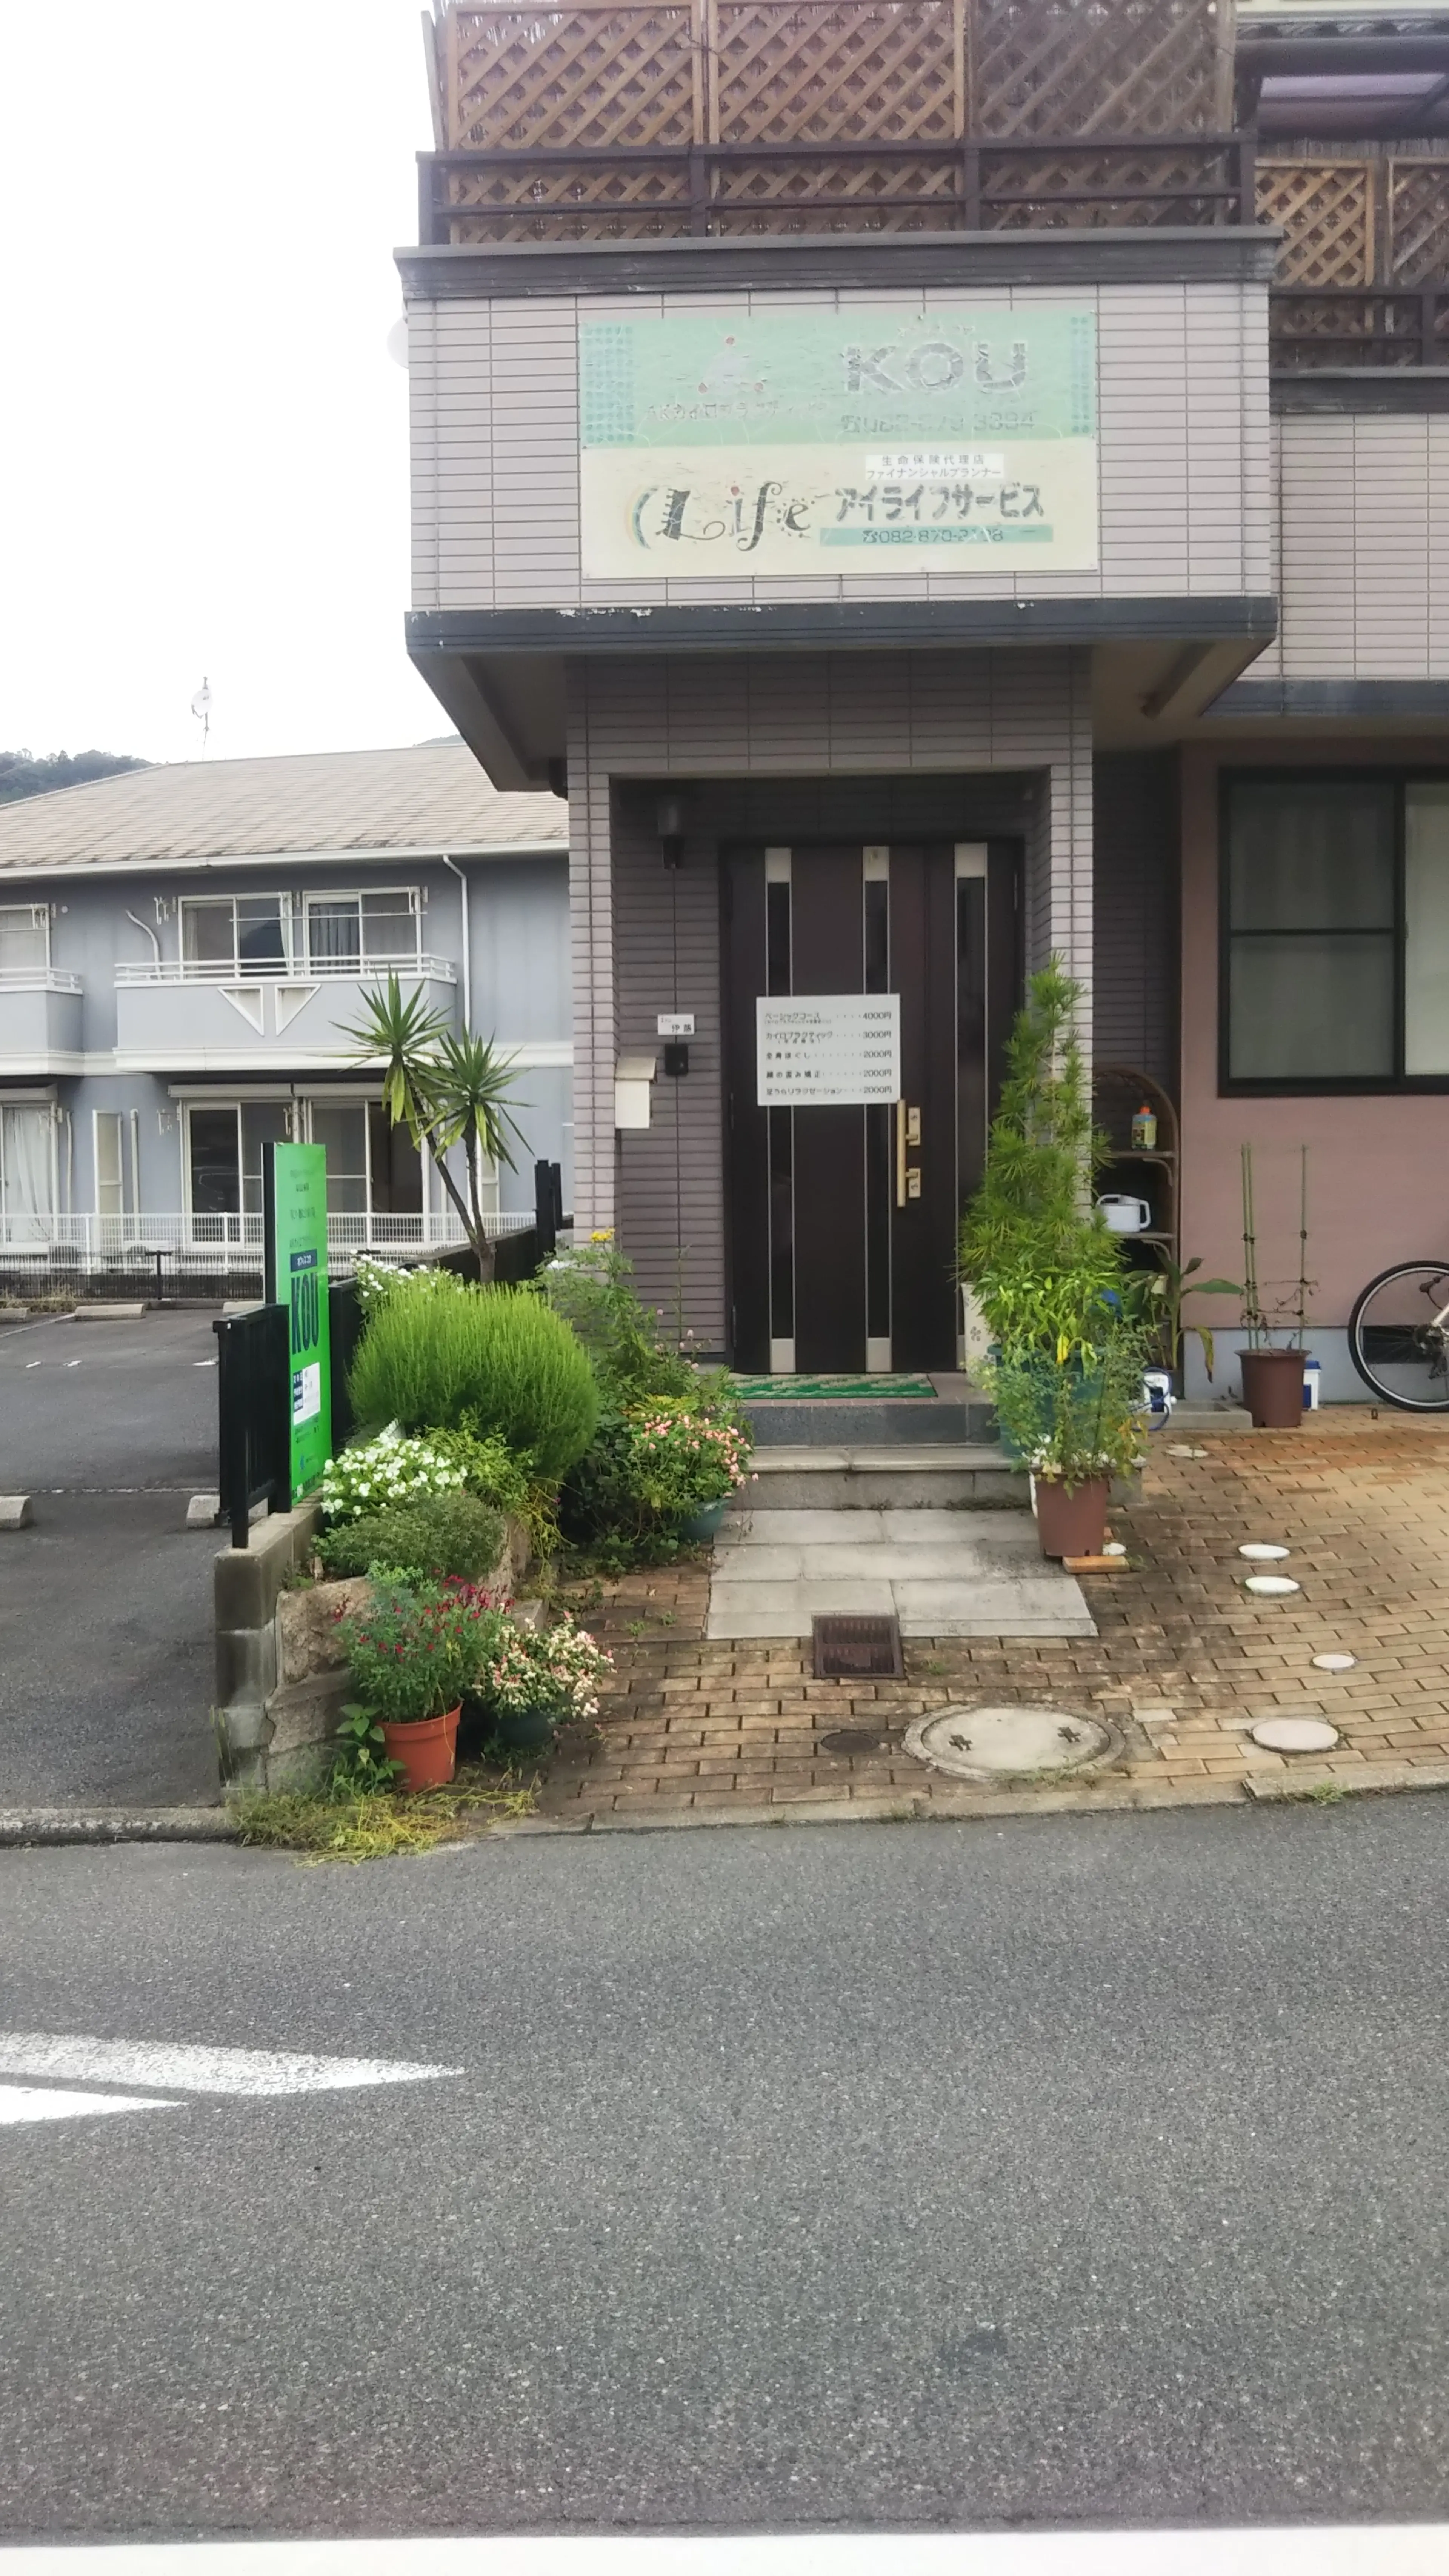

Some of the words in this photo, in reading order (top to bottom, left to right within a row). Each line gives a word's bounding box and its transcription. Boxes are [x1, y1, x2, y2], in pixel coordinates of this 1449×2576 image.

[846, 343, 1026, 391] KOU
[882, 455, 984, 466] 生命保険代理店
[867, 468, 1001, 479] ファイナンシャルプランナー
[835, 482, 1044, 521] アイライフサービス
[863, 1011, 892, 1020] 4000円
[291, 1272, 319, 1355] KOU
